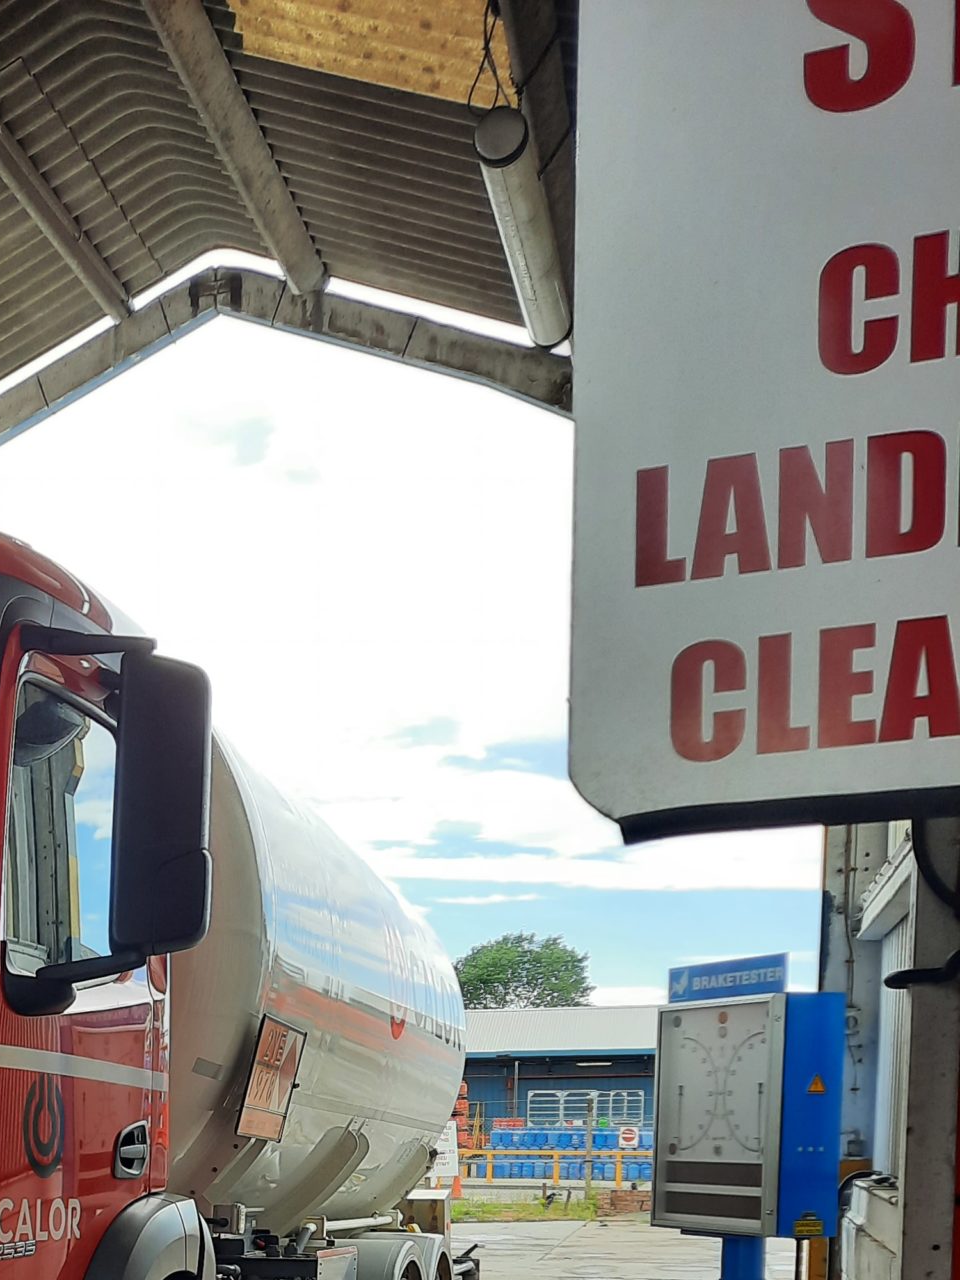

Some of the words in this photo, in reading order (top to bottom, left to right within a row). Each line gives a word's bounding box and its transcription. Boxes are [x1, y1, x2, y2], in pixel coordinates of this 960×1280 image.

[803, 0, 960, 113] S
[635, 430, 960, 588] LAND
[692, 966, 784, 991] BRAKETESTER
